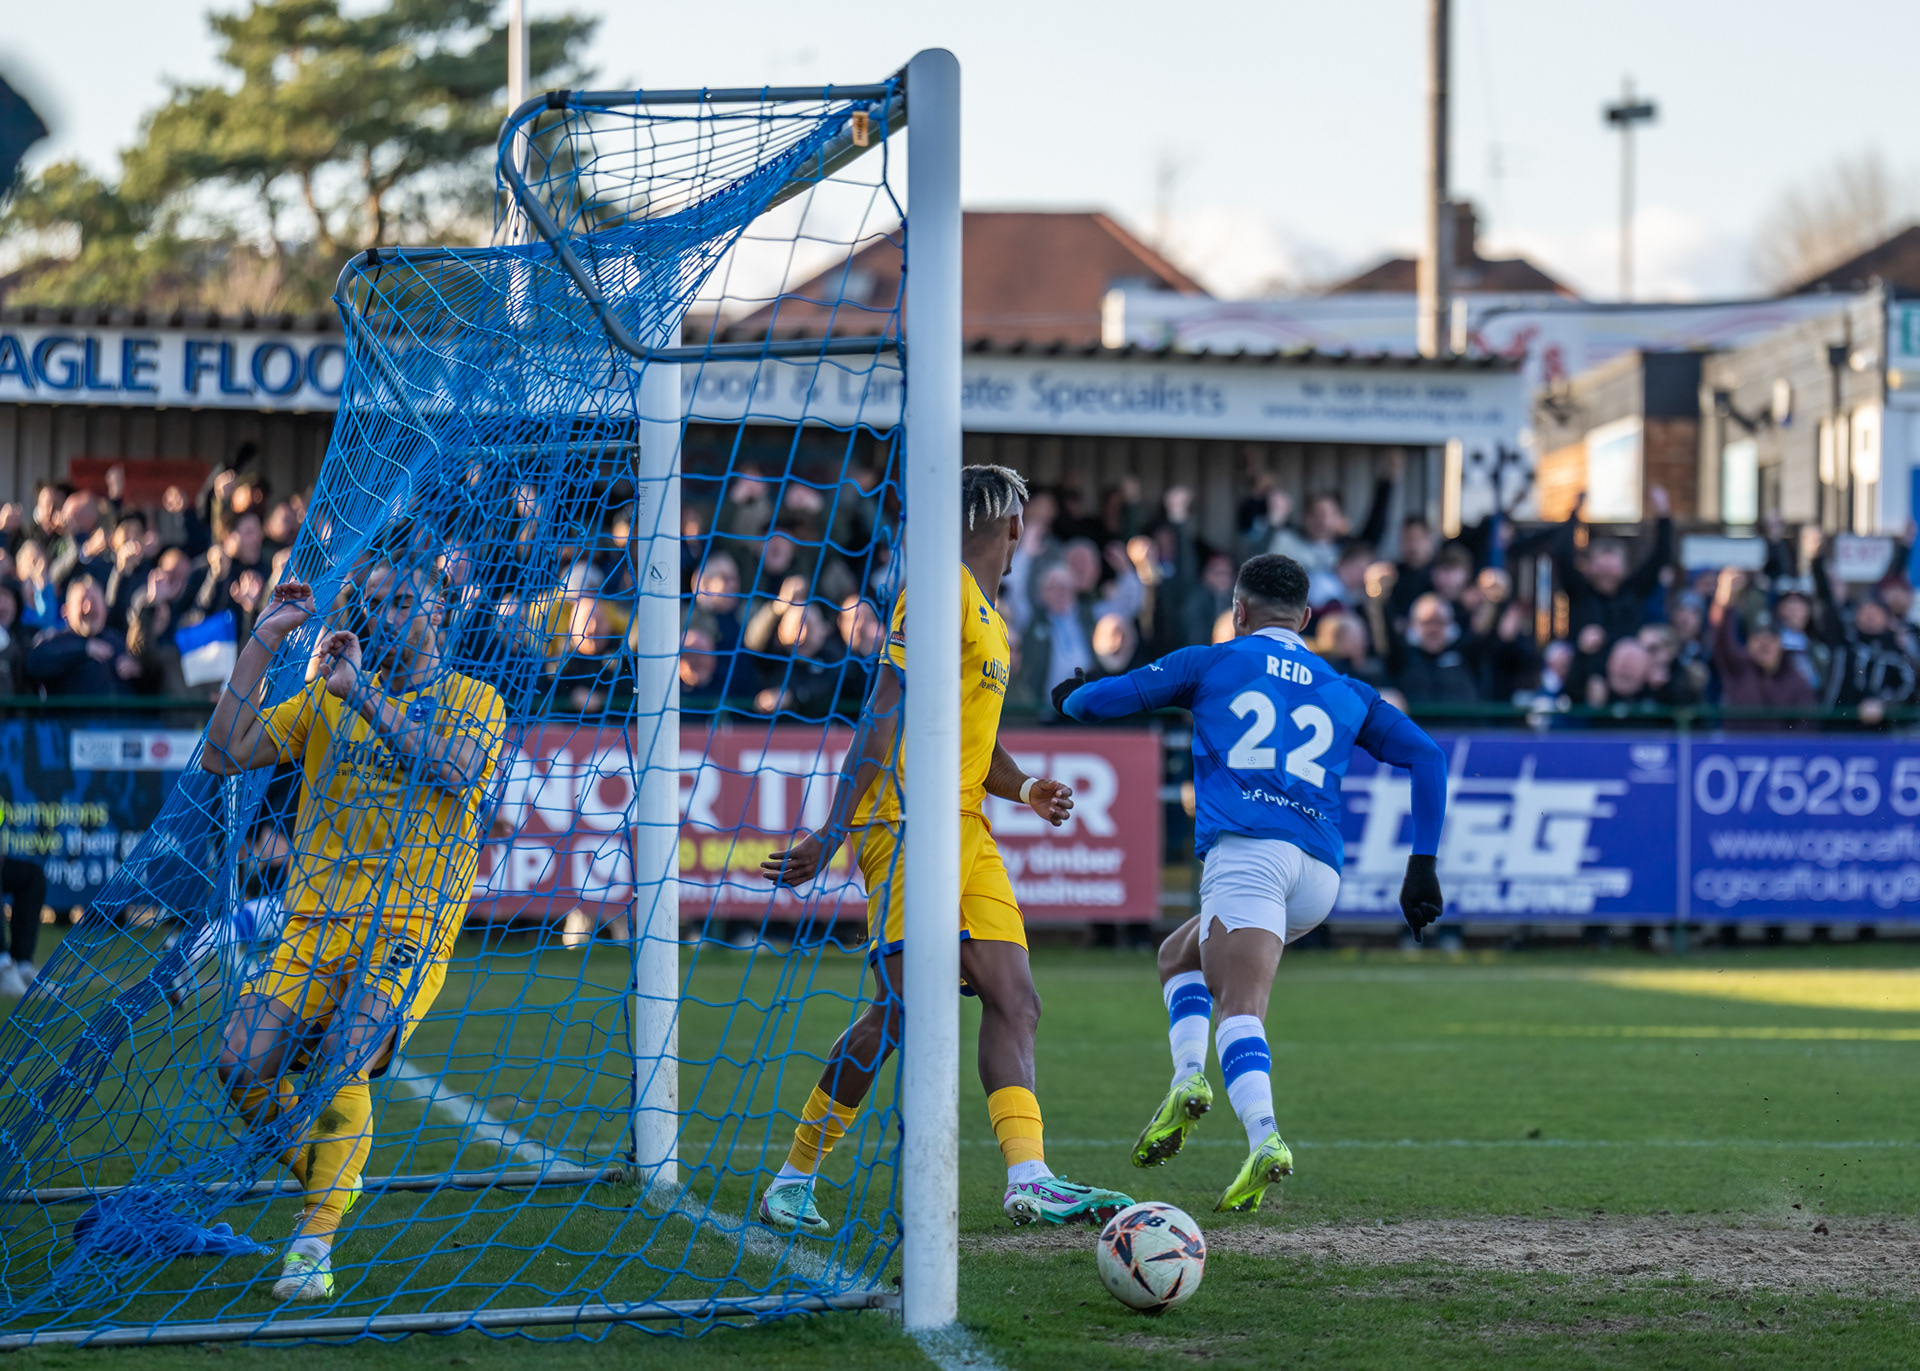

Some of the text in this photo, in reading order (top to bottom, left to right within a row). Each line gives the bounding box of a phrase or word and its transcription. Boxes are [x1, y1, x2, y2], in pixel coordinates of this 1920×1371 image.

[681, 360, 778, 403] ood
[838, 368, 1016, 413] Laate
[1266, 654, 1313, 686] REID
[1227, 690, 1334, 789] 22
[737, 748, 1118, 838] TIER
[1694, 755, 1881, 816] 07525
[1014, 876, 1127, 906] usiness
